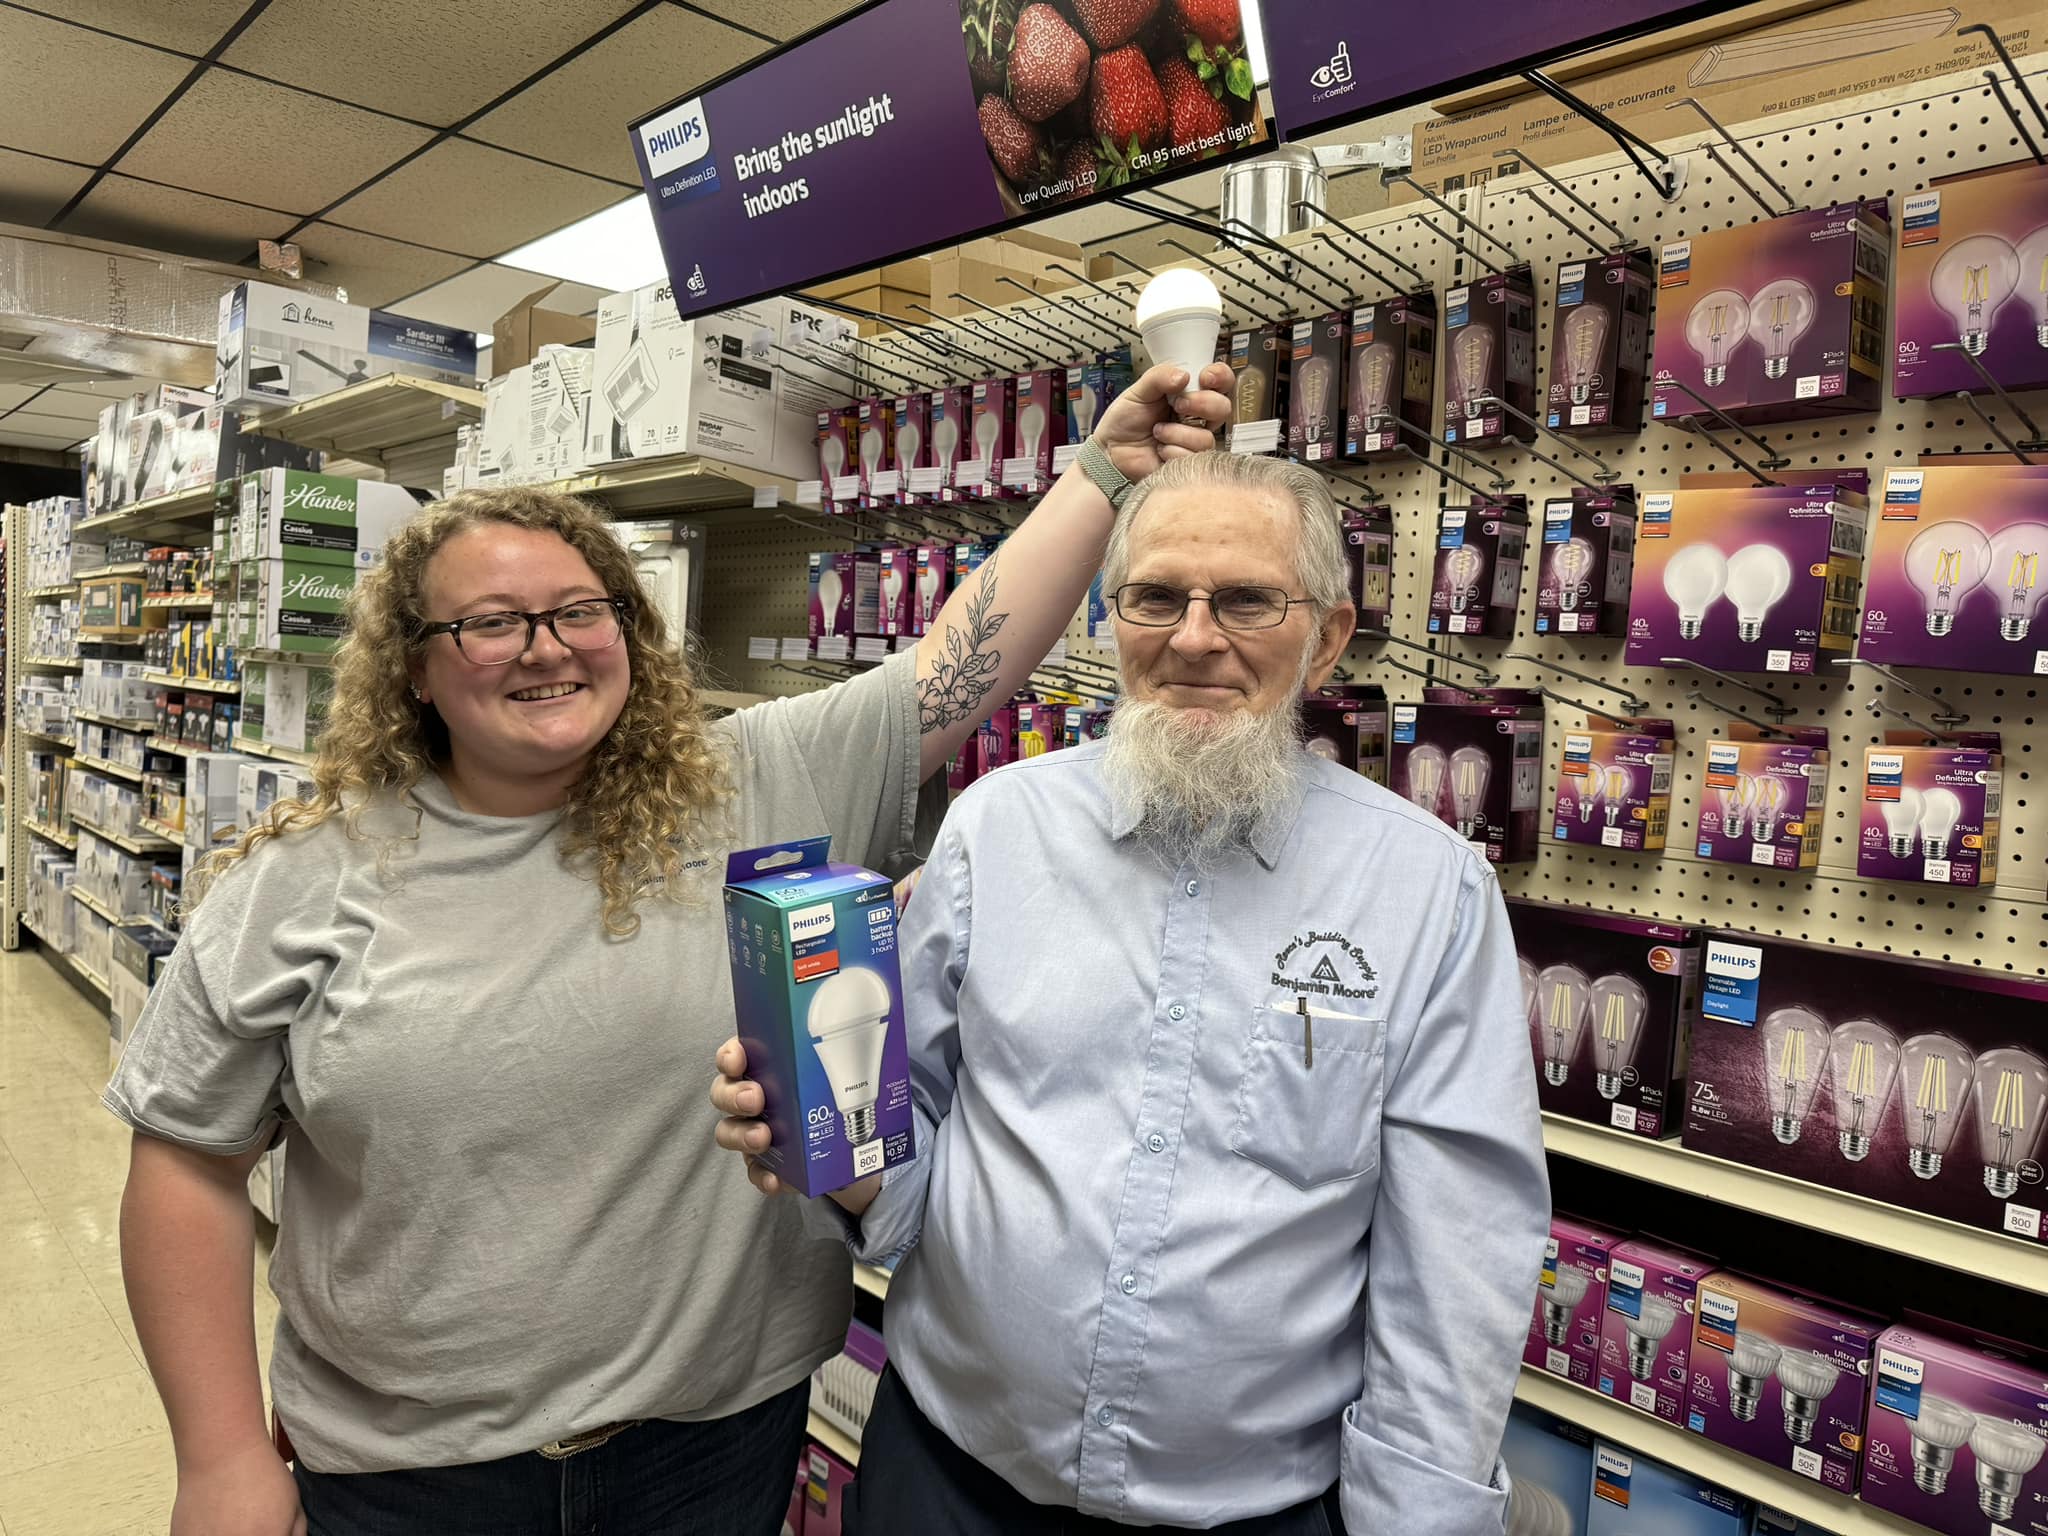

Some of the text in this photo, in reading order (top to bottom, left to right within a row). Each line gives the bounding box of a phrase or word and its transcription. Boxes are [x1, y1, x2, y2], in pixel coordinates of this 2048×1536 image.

[1523, 114, 1560, 131] Lampe
[1617, 84, 1676, 107] couvrante
[649, 116, 702, 158] PHILIPS
[734, 92, 895, 181] Bring the sunlight
[1424, 126, 1507, 156] LED Wraparound
[1131, 121, 1257, 171] CRI 95 next best light
[660, 166, 717, 199] Ultra Definition LED
[1019, 170, 1098, 206] Low Quality LED
[743, 177, 810, 219] indoors
[1906, 199, 1937, 211] PHILIPS
[1828, 220, 1846, 229] Ultra
[1810, 227, 1846, 239] Definition
[1664, 247, 1689, 258] PHILIPS
[304, 307, 335, 328] home
[1828, 350, 1845, 360] Pack
[1800, 385, 1814, 394] 350
[667, 425, 679, 436] 2.0
[1890, 478, 1920, 487] PHILIPS
[282, 483, 357, 513] Hunter
[1646, 499, 1671, 507] PHILIPS
[1788, 507, 1824, 515] Definition
[1800, 629, 1817, 637] Pack
[1711, 751, 1736, 759] PHILIPS
[1765, 766, 1799, 775] Definition
[1871, 761, 1900, 769] PHILIPS
[1935, 774, 1973, 783] Definition
[1954, 769, 1973, 777] Ultra
[1960, 825, 1979, 833] Pack
[1756, 852, 1769, 860] 450
[1928, 869, 1944, 877] 450
[792, 913, 832, 931] PHILIPS
[869, 924, 893, 936] battery
[870, 930, 894, 942] backup
[877, 939, 888, 949] up
[795, 948, 807, 957] LED
[1304, 931, 1378, 982] Building Supply
[1711, 953, 1757, 969] PHILIPS
[1271, 972, 1330, 995] Benjamin
[1728, 987, 1741, 995] LED
[844, 1080, 869, 1093] PHILIPS
[1645, 1086, 1662, 1097] Pack
[1711, 1108, 1728, 1120] LED
[820, 1126, 834, 1135] LED
[2011, 1216, 2031, 1229] 800
[1559, 1261, 1594, 1278] Definition
[1577, 1260, 1594, 1271] Ultra
[1613, 1267, 1641, 1282] PHILIPS
[1645, 1291, 1682, 1309] Definition
[1664, 1291, 1682, 1302] Ultra
[1703, 1298, 1735, 1314] PHILIPS
[1812, 1349, 1855, 1371] Definition
[1834, 1349, 1856, 1363] Ultra
[1882, 1358, 1920, 1376] PHILIPS
[1829, 1416, 1856, 1432] 2 Pack
[1600, 1453, 1629, 1471] PHILIPS
[1798, 1459, 1815, 1471] 505
